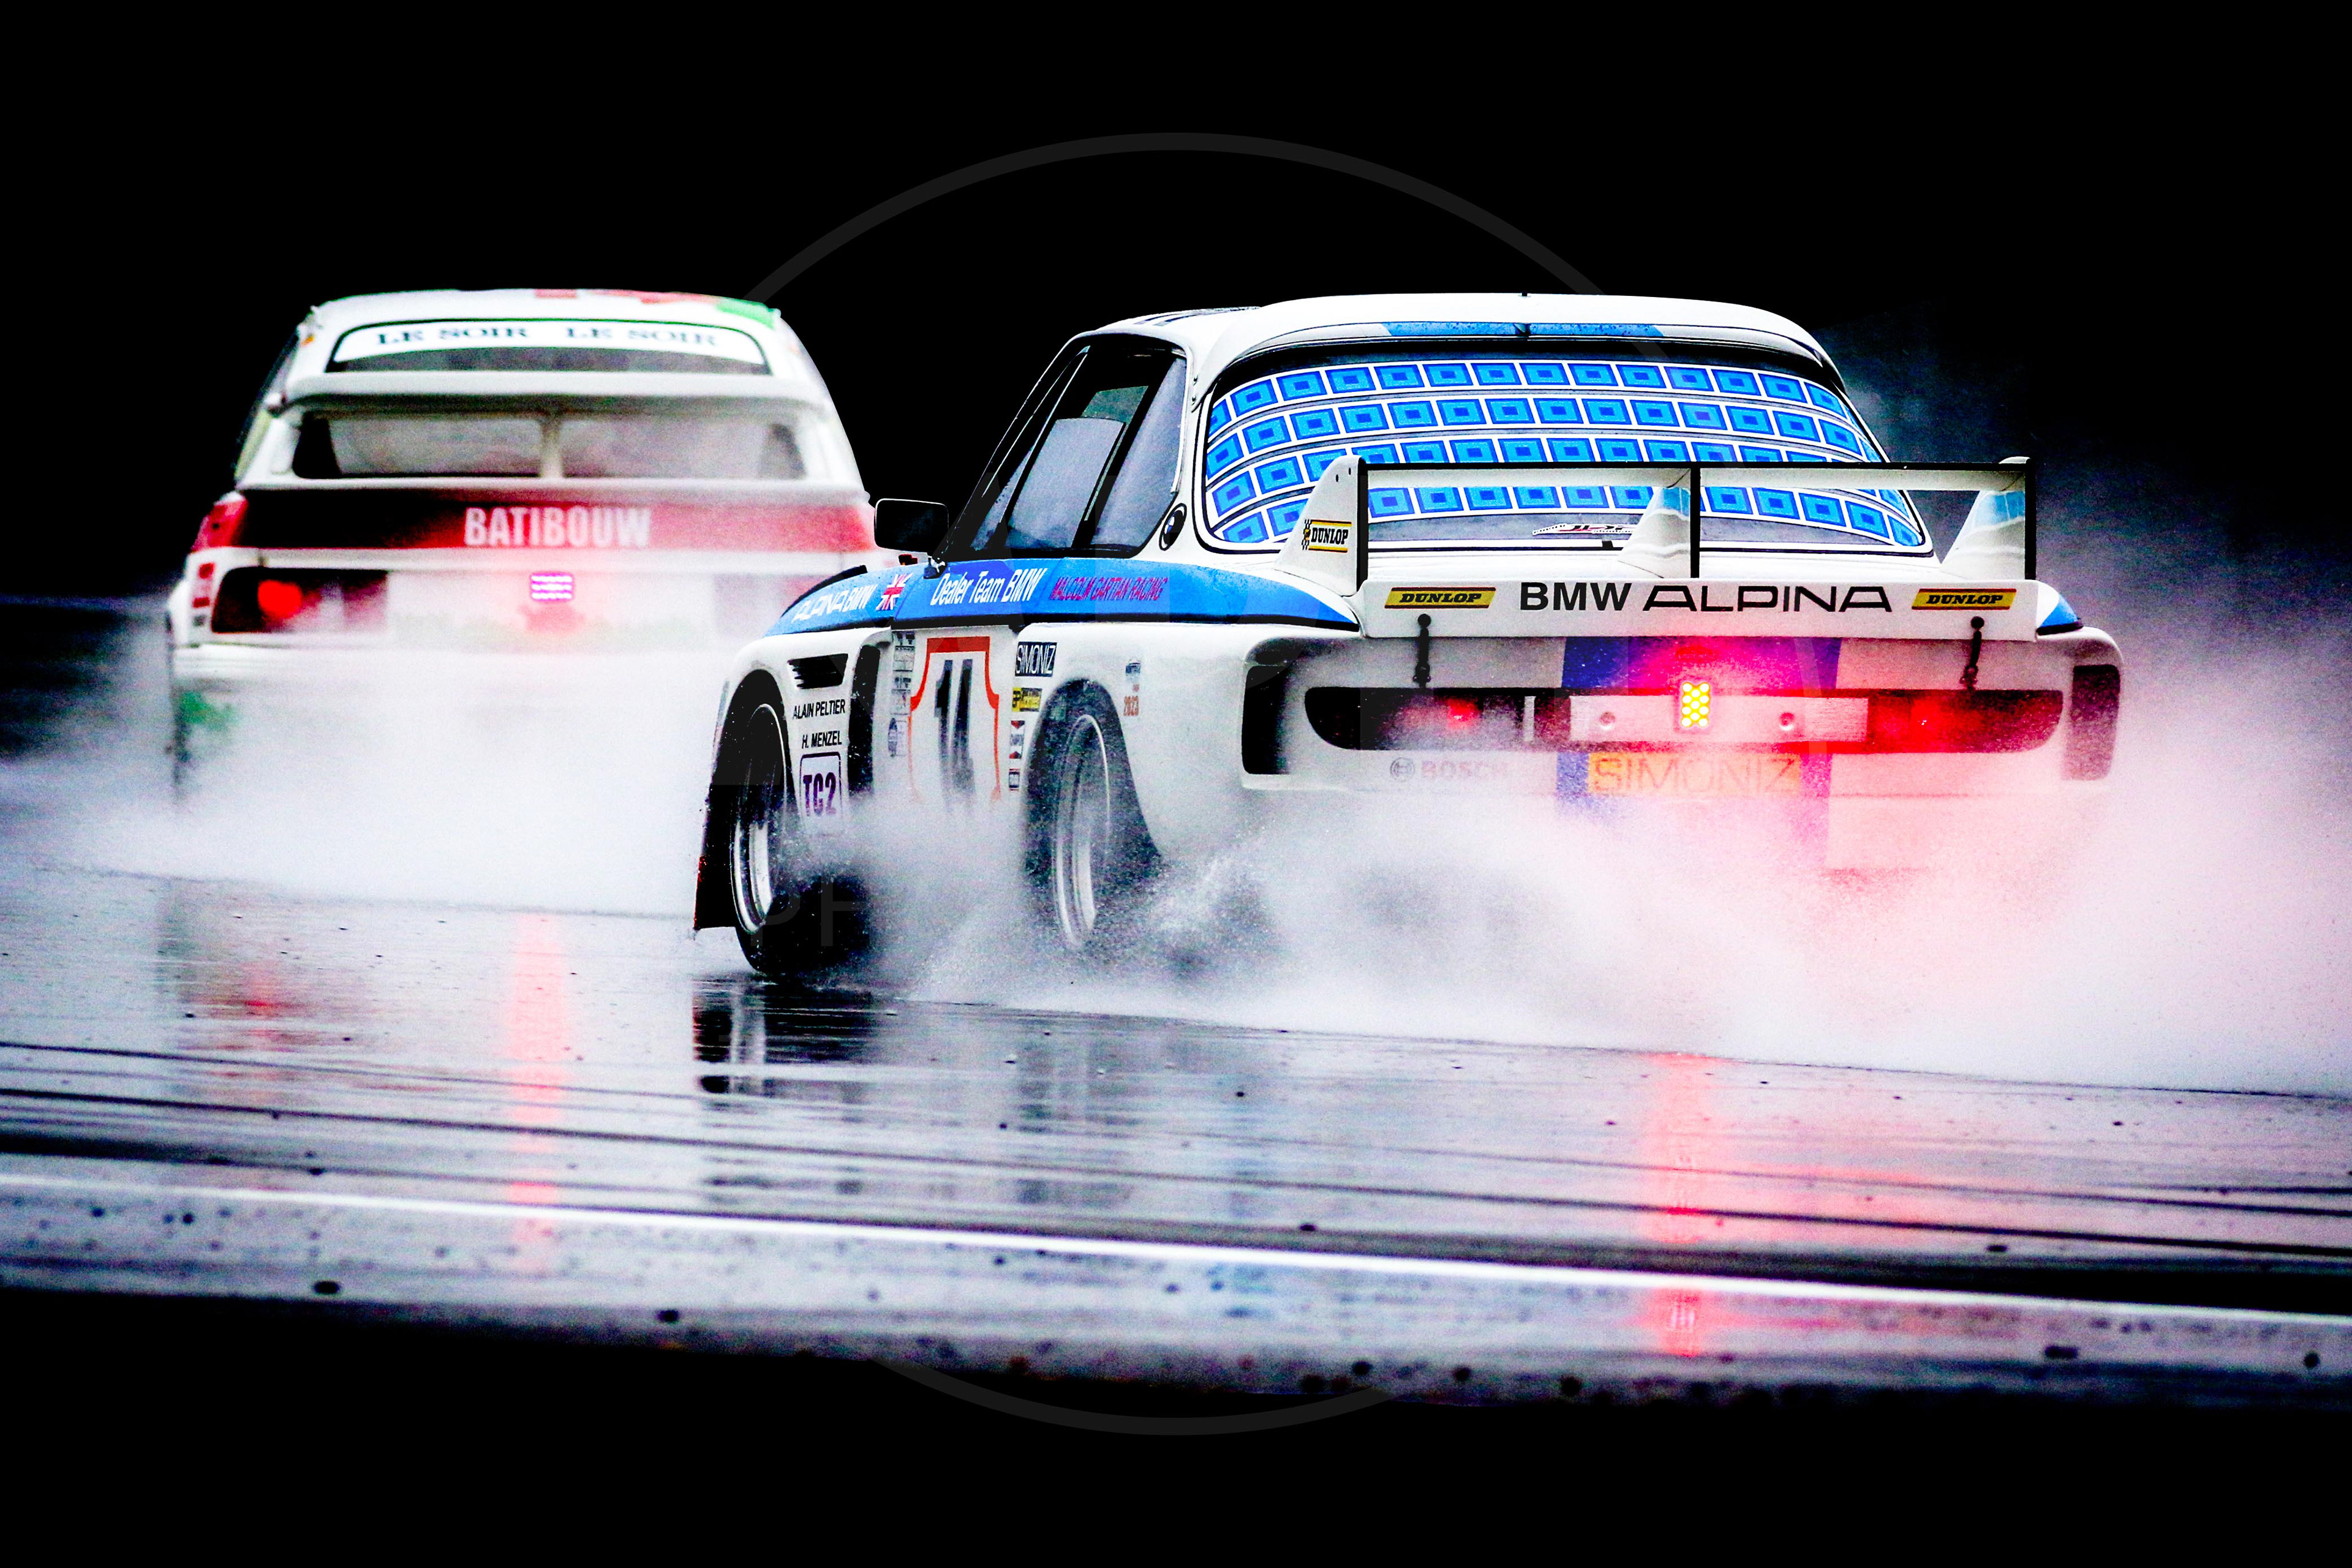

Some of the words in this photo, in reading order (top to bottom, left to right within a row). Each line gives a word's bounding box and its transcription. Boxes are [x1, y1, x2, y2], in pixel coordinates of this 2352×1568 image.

[377, 330, 423, 345] LE
[439, 326, 529, 341] SOIR
[565, 326, 613, 341] LE
[627, 329, 717, 347] SOIR
[464, 505, 652, 548] BATIBOUW
[1311, 527, 1349, 545] DUNLOP
[842, 584, 878, 612] BMW
[930, 571, 973, 606] Dealer
[969, 570, 1006, 603] Team
[1001, 568, 1048, 602] BMW
[1399, 592, 1482, 604] DUNLOP
[1520, 581, 1632, 611] BMW
[1642, 584, 1893, 612] ALPINA
[1926, 594, 2003, 605] DUNLOP
[1016, 644, 1056, 674] SIMONIZ
[792, 703, 815, 720] ALAIN
[815, 698, 845, 717] PELTIER
[801, 734, 809, 749] H.
[811, 730, 842, 748] MENZEL
[1421, 760, 1510, 781] BOSCH
[1594, 756, 1797, 793] SIMONIZ
[802, 772, 837, 816] TC2
